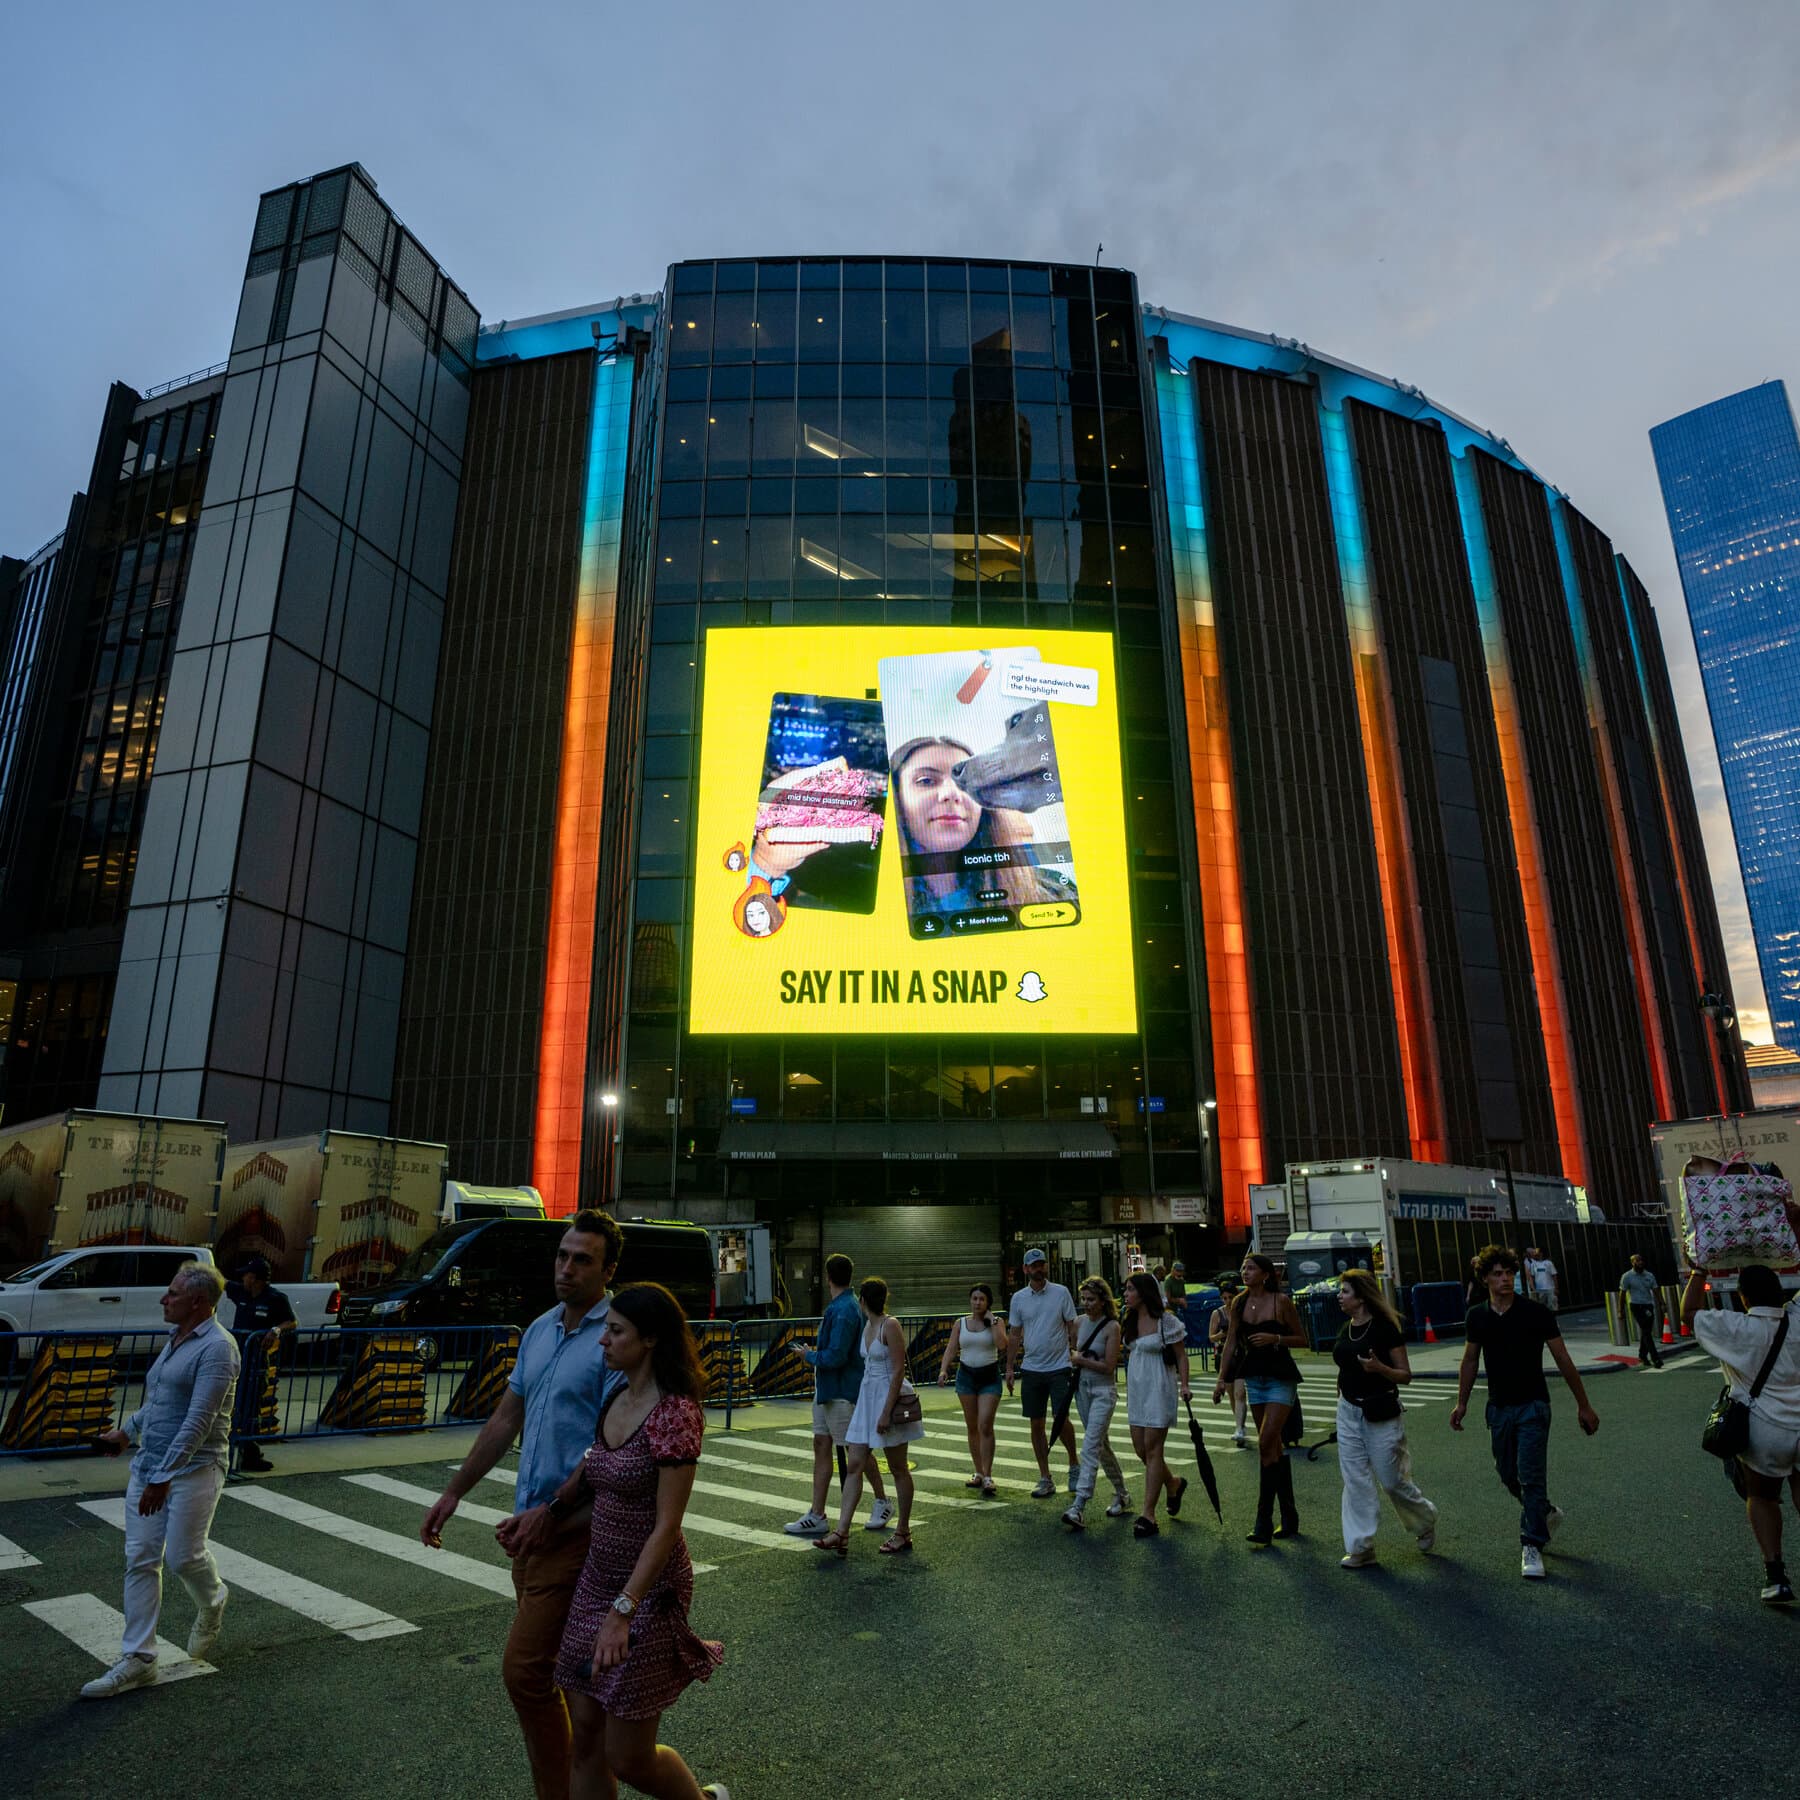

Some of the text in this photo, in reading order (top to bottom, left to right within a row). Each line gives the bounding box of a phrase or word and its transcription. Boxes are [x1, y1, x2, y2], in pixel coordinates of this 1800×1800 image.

[1011, 674, 1090, 690] ngl the sandwich was
[1024, 684, 1058, 695] highlight
[787, 793, 857, 807] mid show pastrami?
[994, 852, 1010, 862] tbh
[986, 915, 1009, 923] Friends
[780, 970, 1007, 1004] SAY IT IN A SNAP
[88, 1137, 202, 1156] TRVELLER
[1674, 1132, 1790, 1153] TRAVELLER
[739, 1151, 756, 1160] PENN
[756, 1151, 777, 1160] PLAZA
[1081, 1150, 1113, 1159] ENTRANCE
[341, 1154, 431, 1174] TRAVELLER
[1402, 1202, 1429, 1219] TOP
